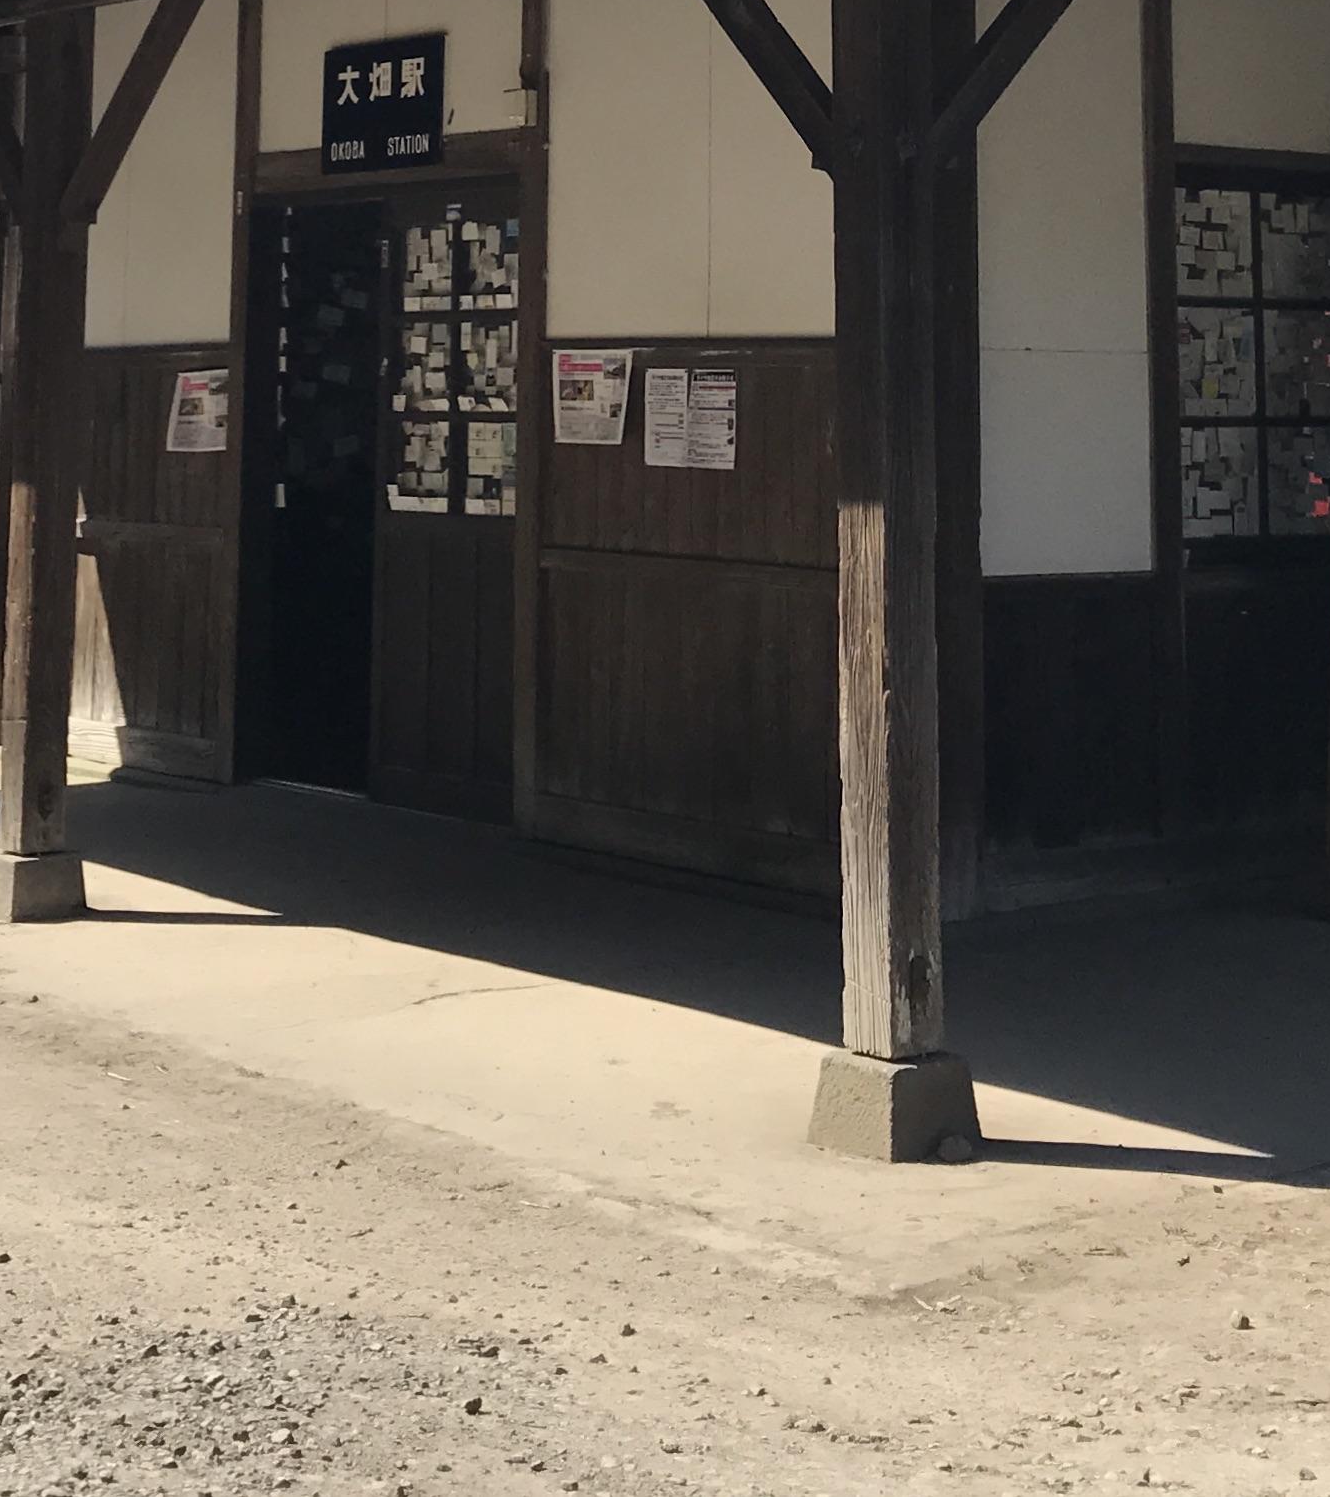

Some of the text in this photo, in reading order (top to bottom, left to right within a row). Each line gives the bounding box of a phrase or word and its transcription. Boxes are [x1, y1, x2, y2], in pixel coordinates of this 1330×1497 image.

[337, 56, 425, 106] 大畑駅
[330, 134, 429, 161] OKOBA STATION
